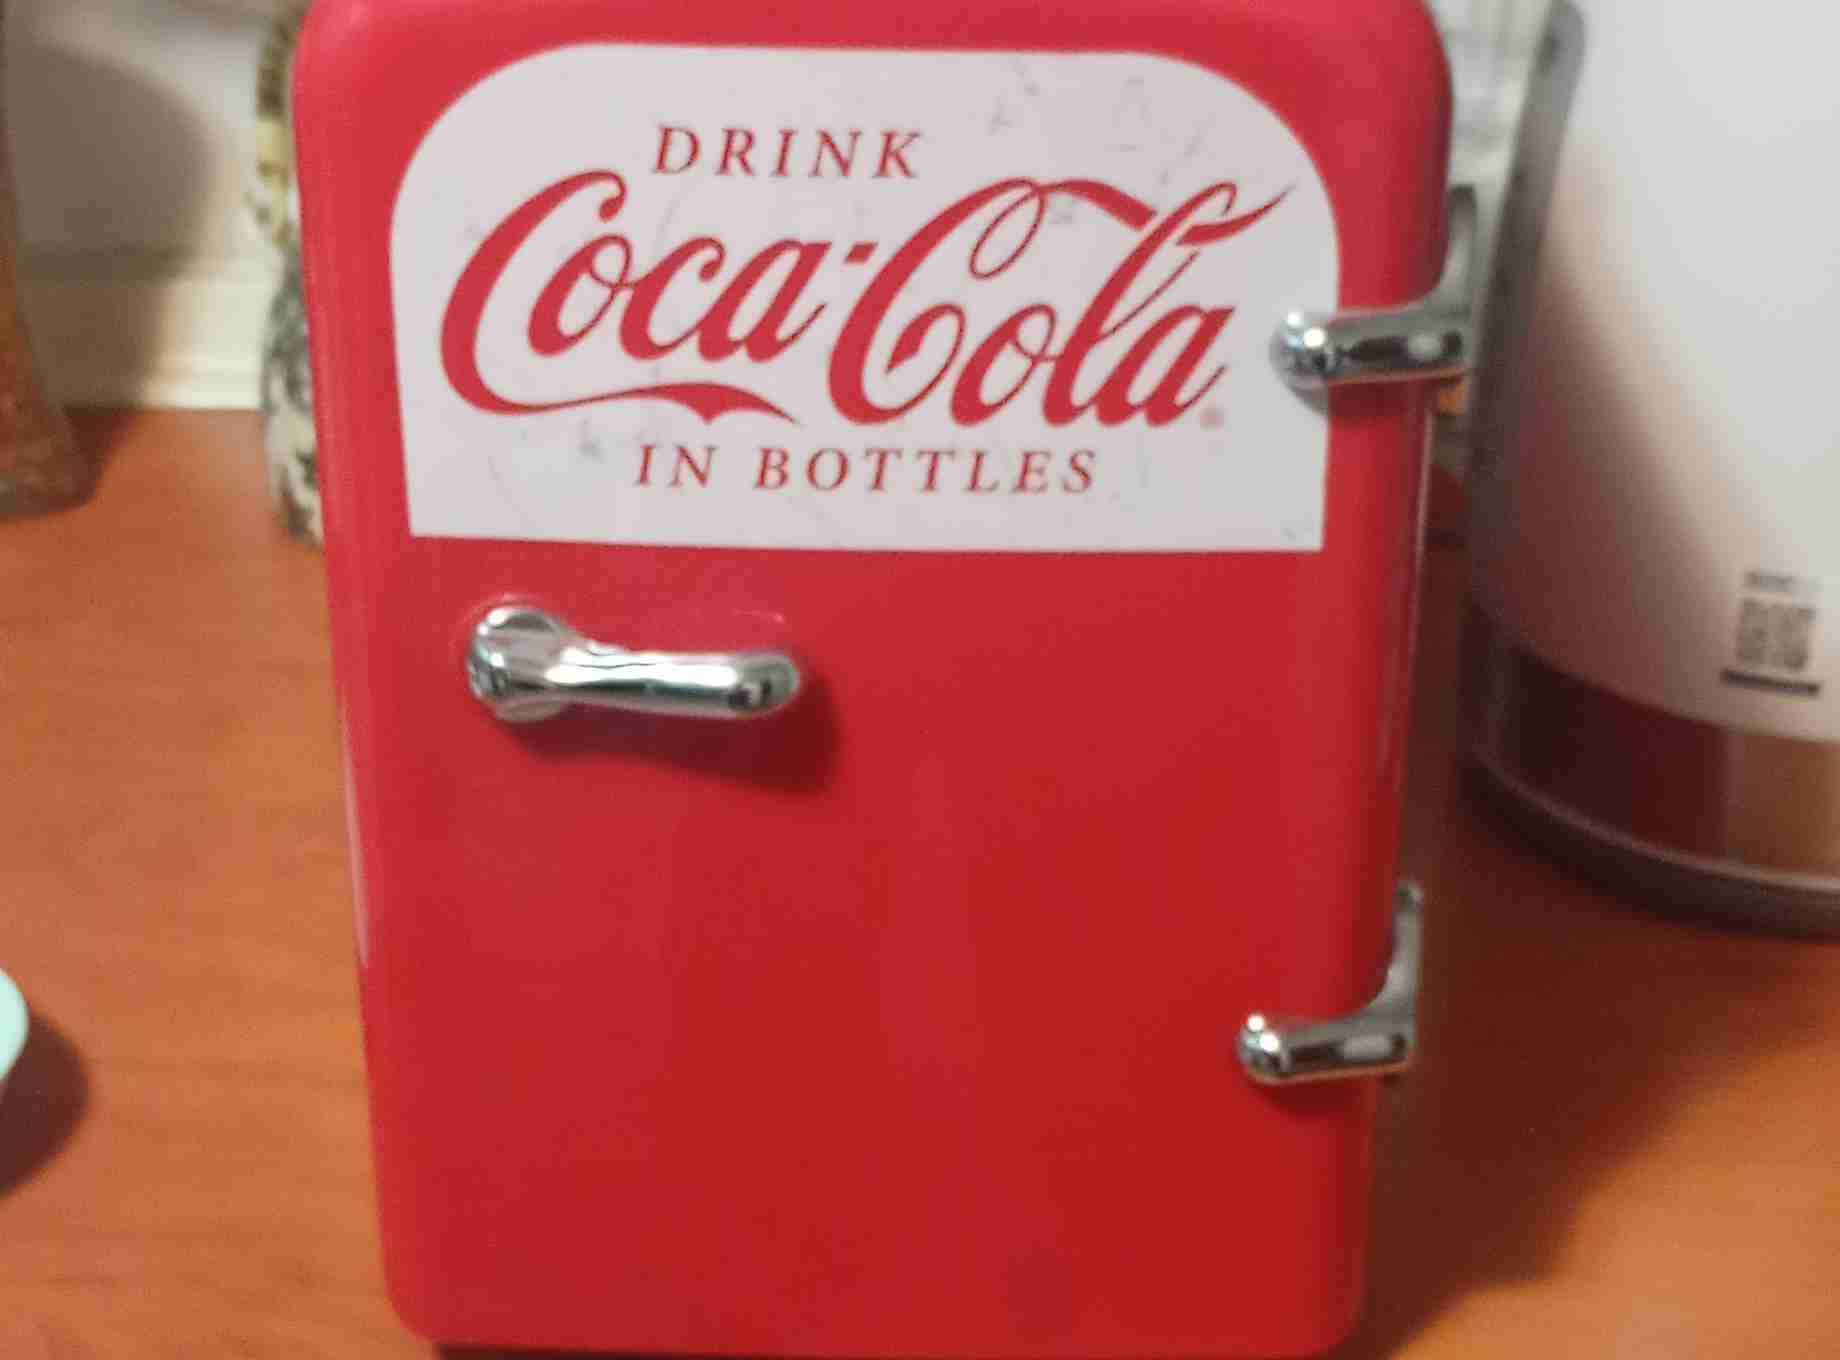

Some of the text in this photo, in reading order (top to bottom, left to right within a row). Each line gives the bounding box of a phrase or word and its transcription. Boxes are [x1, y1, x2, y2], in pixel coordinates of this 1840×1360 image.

[653, 125, 925, 179] DRINK
[440, 169, 1297, 427] Coca-Cola
[636, 443, 1098, 495] IN BOTTLES
